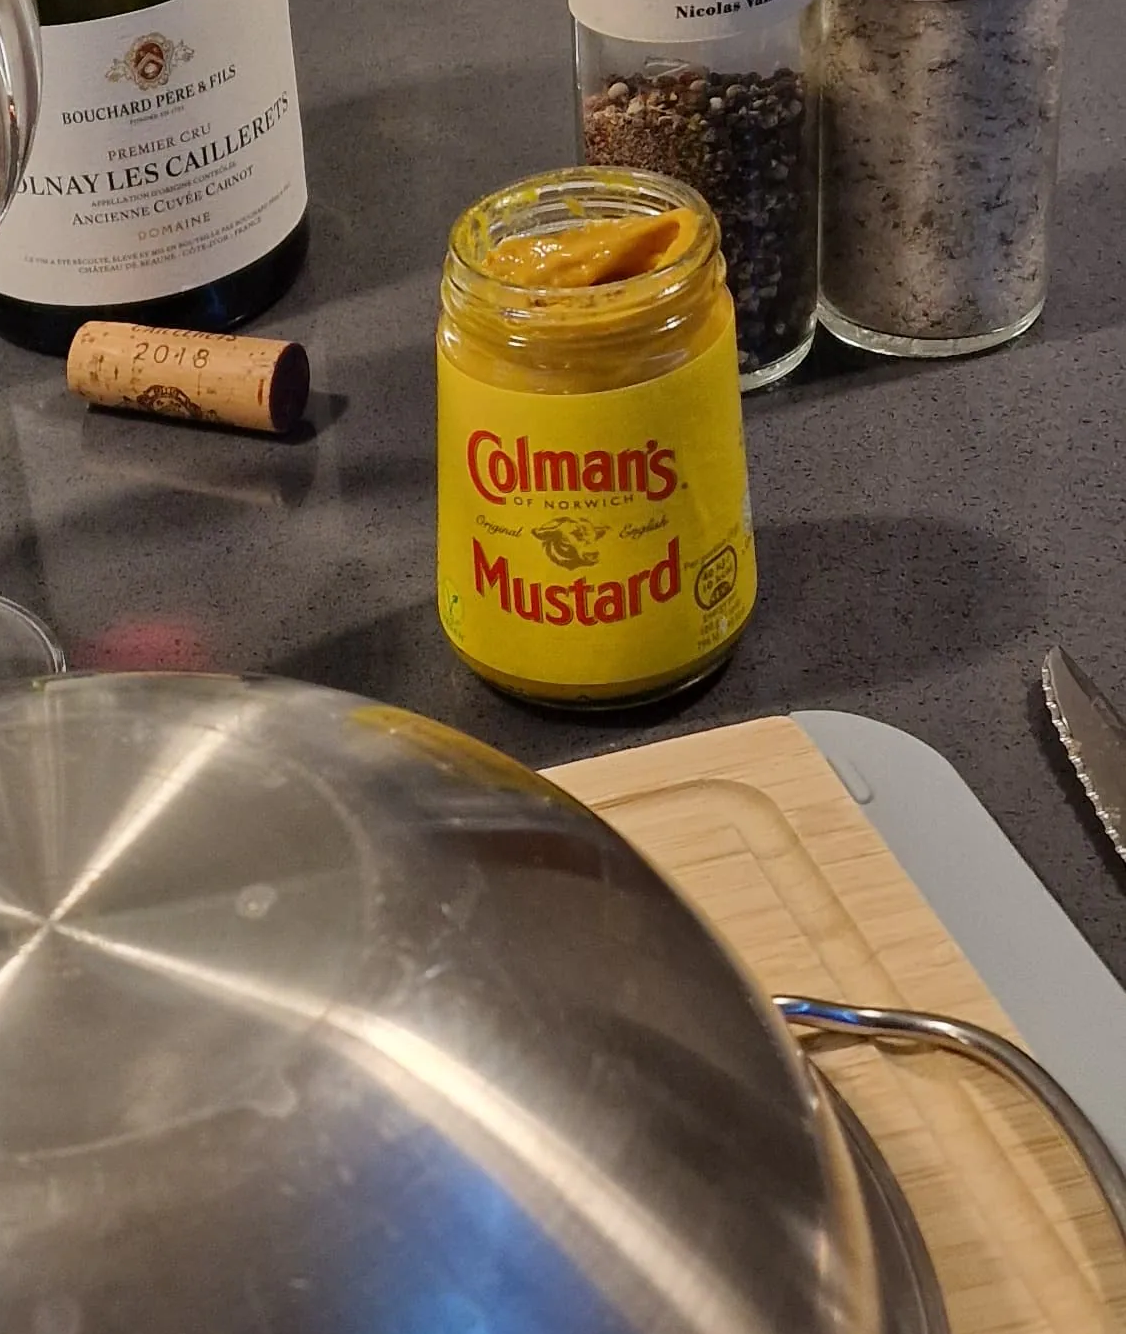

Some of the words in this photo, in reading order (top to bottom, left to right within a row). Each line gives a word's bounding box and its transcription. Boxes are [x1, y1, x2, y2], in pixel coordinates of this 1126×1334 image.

[675, 1, 741, 19] Nicolas
[62, 97, 152, 125] BOUCHARD
[155, 84, 196, 109] PÈRE
[198, 79, 207, 93] &
[209, 64, 237, 90] FILS
[107, 162, 160, 192] LES
[164, 91, 289, 178] CAILLERETS
[107, 137, 175, 162] PREMIER
[180, 123, 212, 144] CRU
[72, 205, 151, 227] ANCIENNE
[153, 190, 204, 214] CUVÉE
[205, 164, 255, 196] CARNOT
[91, 192, 149, 207] APPELLATION
[138, 211, 211, 243] DOMAINE
[134, 342, 210, 369] 2018
[467, 429, 679, 505] Colman's
[513, 496, 534, 507] OF
[544, 493, 634, 510] NORWICH
[476, 514, 523, 539] Original
[472, 535, 682, 627] Mustard
